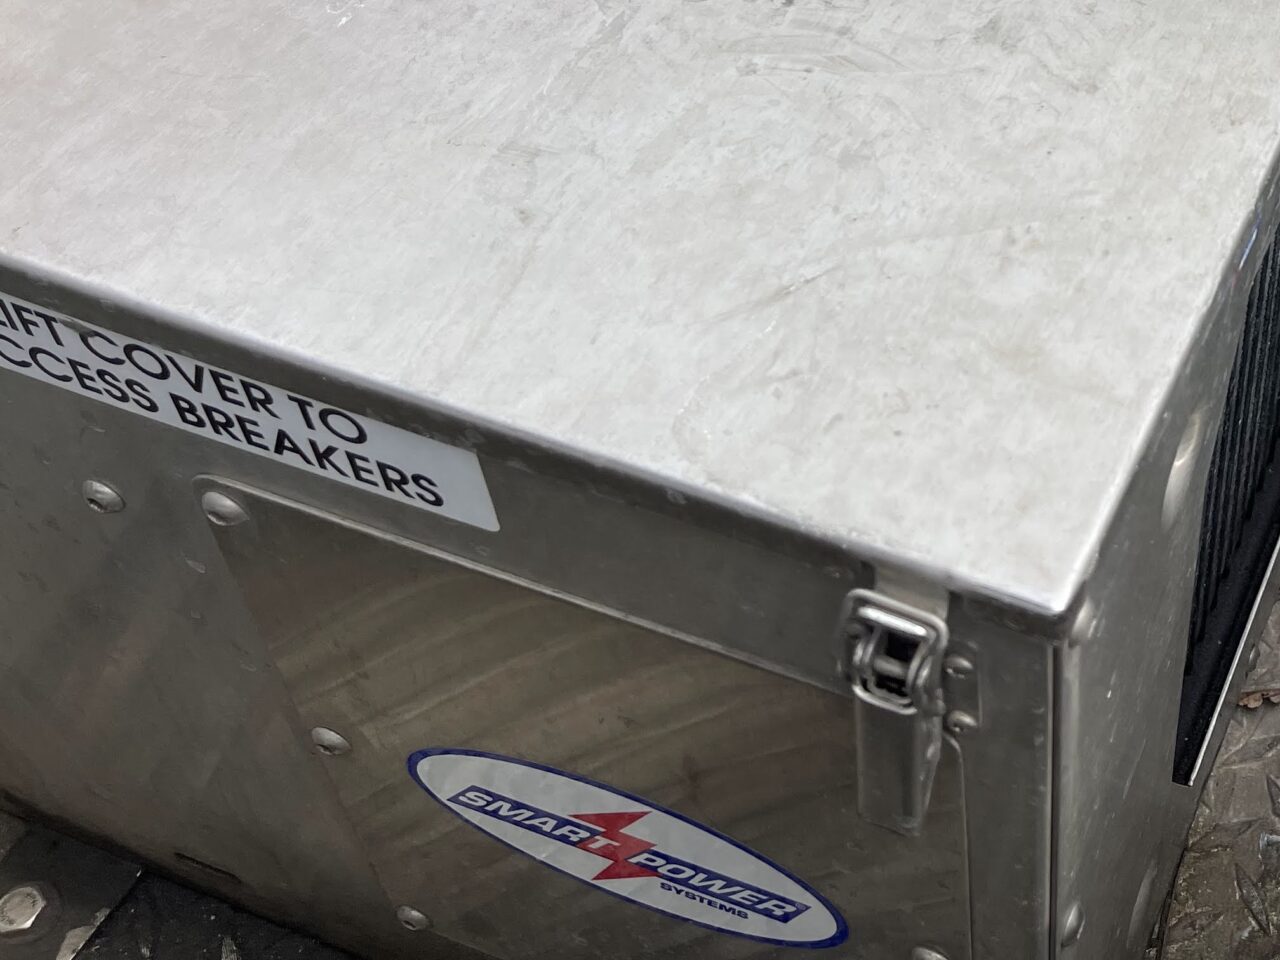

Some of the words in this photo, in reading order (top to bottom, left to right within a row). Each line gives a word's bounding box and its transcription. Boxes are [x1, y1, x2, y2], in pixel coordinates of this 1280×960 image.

[0, 298, 64, 347] IFT
[78, 331, 280, 418] COVER
[288, 394, 368, 444] TO
[168, 392, 444, 507] BREAKERS
[458, 790, 620, 849] SMART
[628, 853, 798, 917] POWER
[660, 881, 749, 919] SYSTEMS
